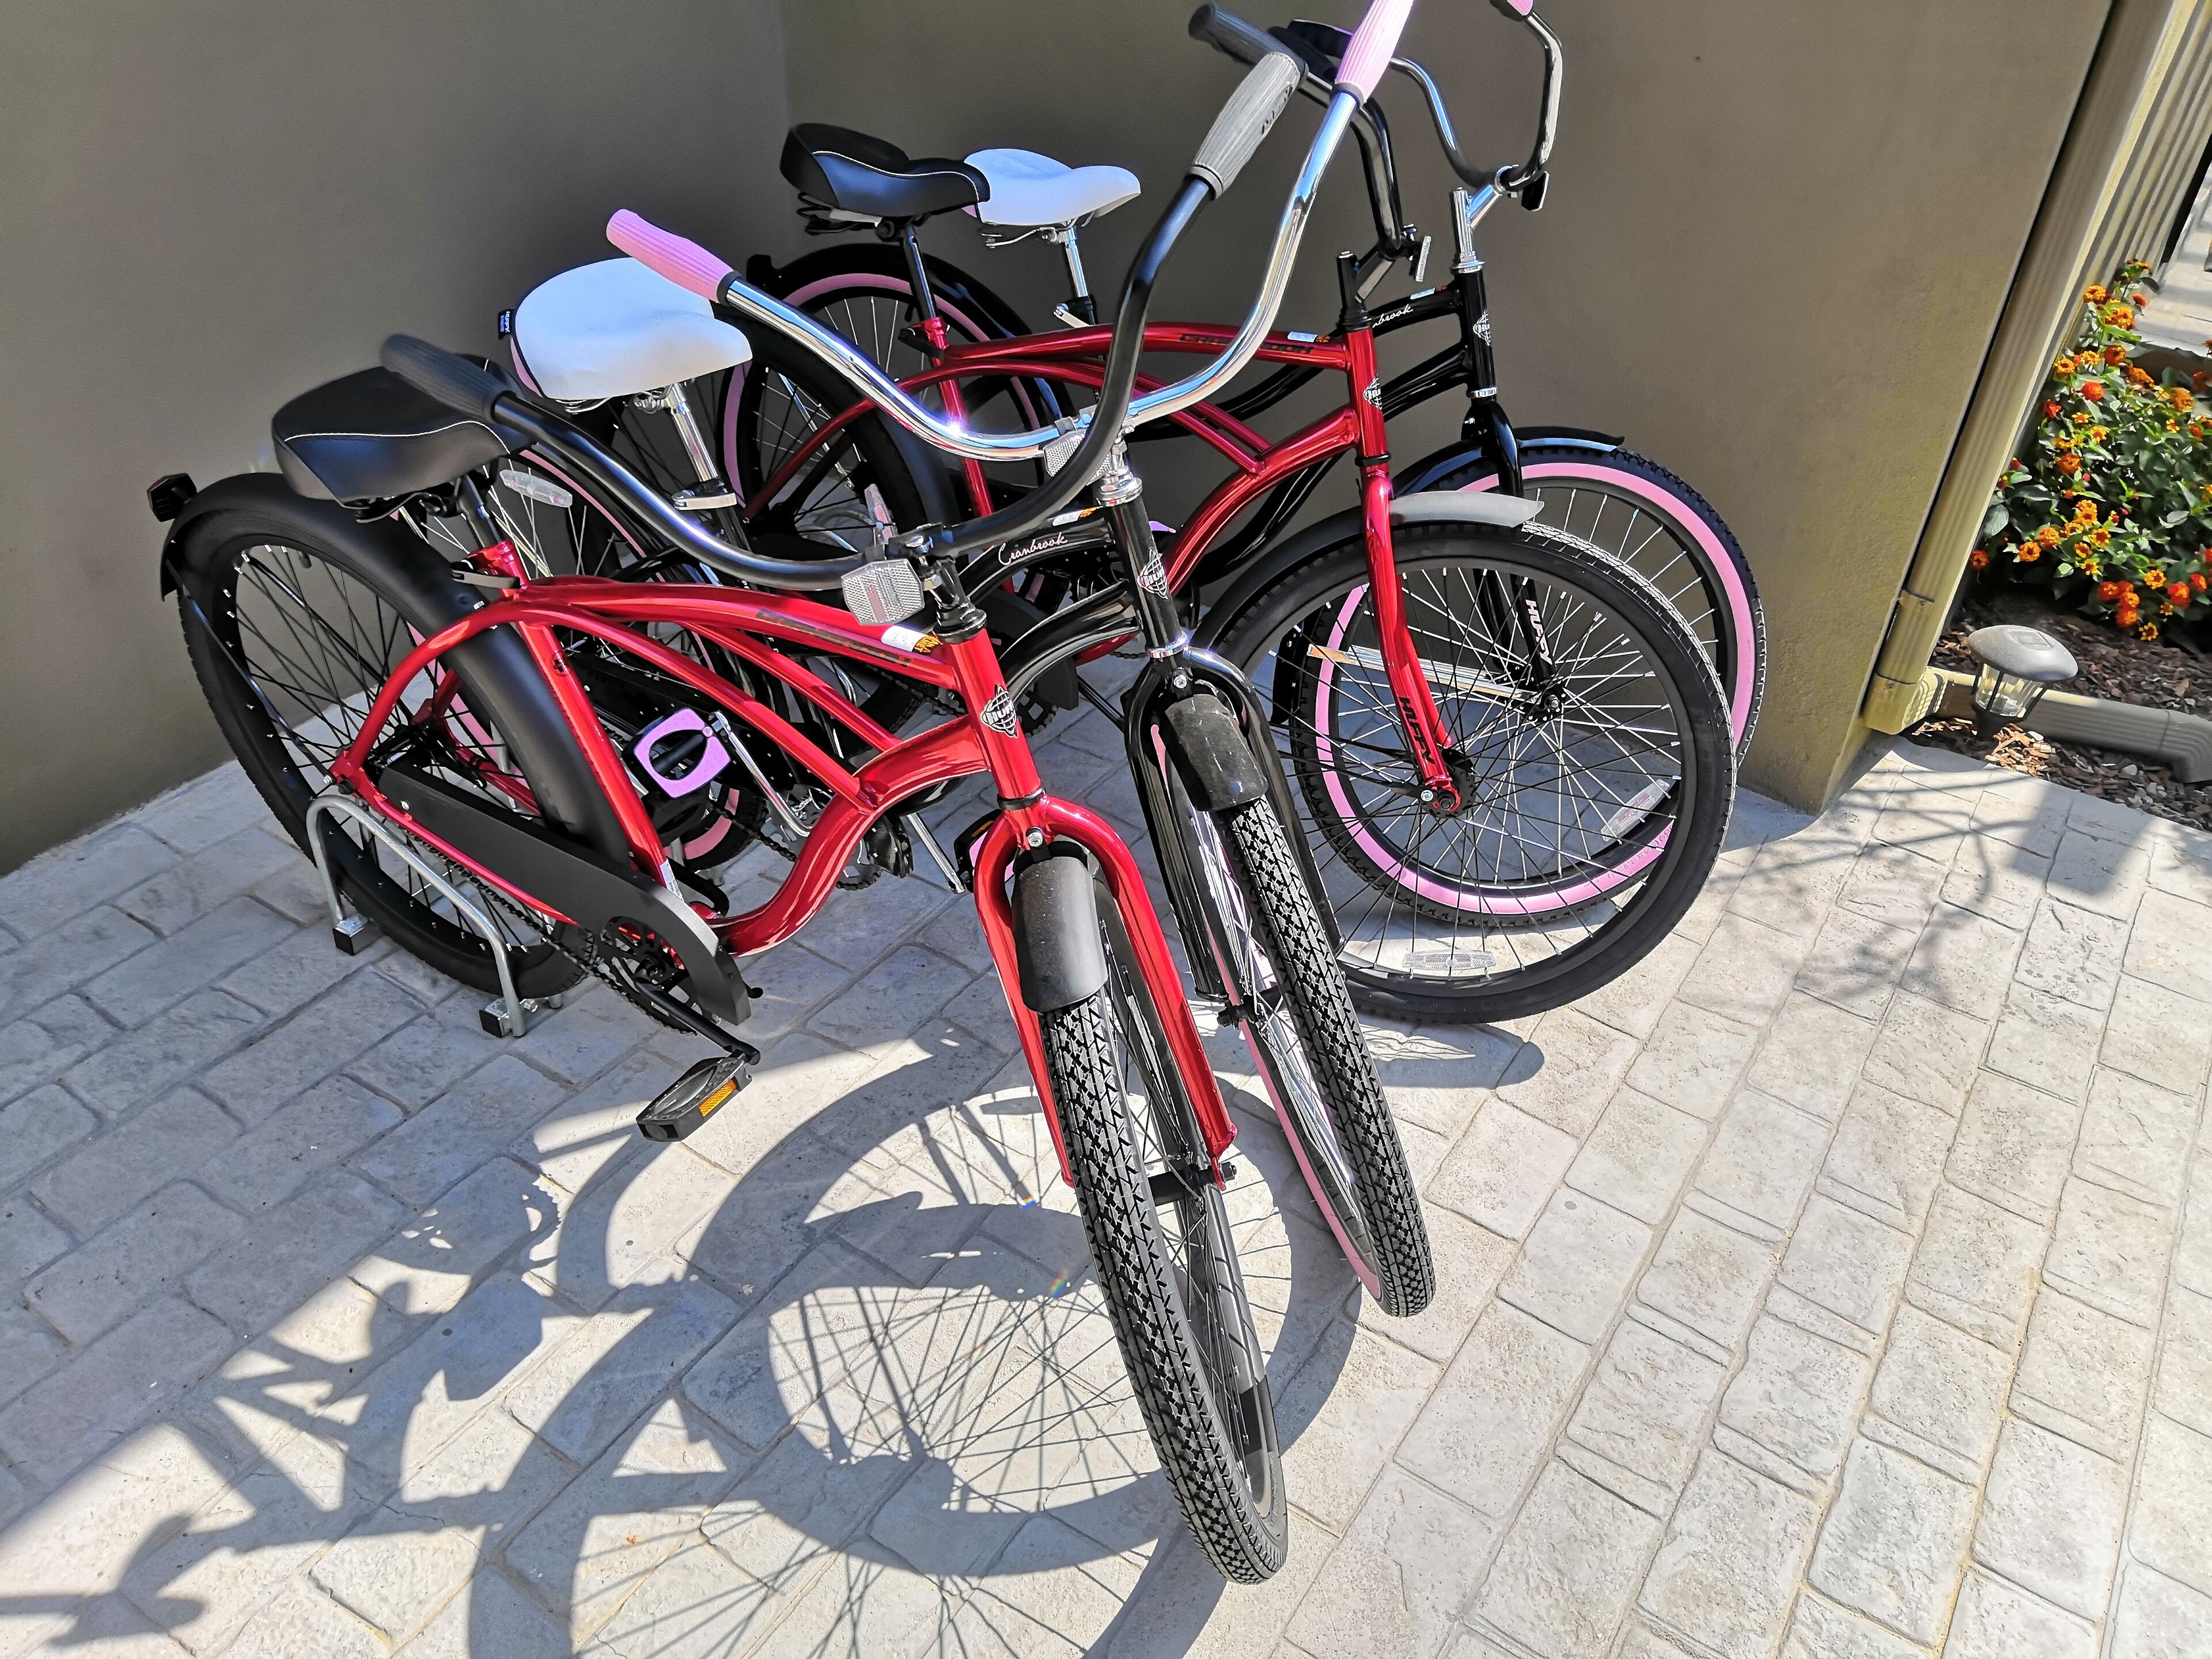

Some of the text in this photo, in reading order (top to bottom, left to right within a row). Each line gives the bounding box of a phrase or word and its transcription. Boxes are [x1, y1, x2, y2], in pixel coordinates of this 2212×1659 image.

[1372, 304, 1414, 328] nbrook
[998, 532, 1069, 566] Cranbrook
[1525, 599, 1553, 665] HUFFY
[1399, 697, 1435, 764] HUFFY
